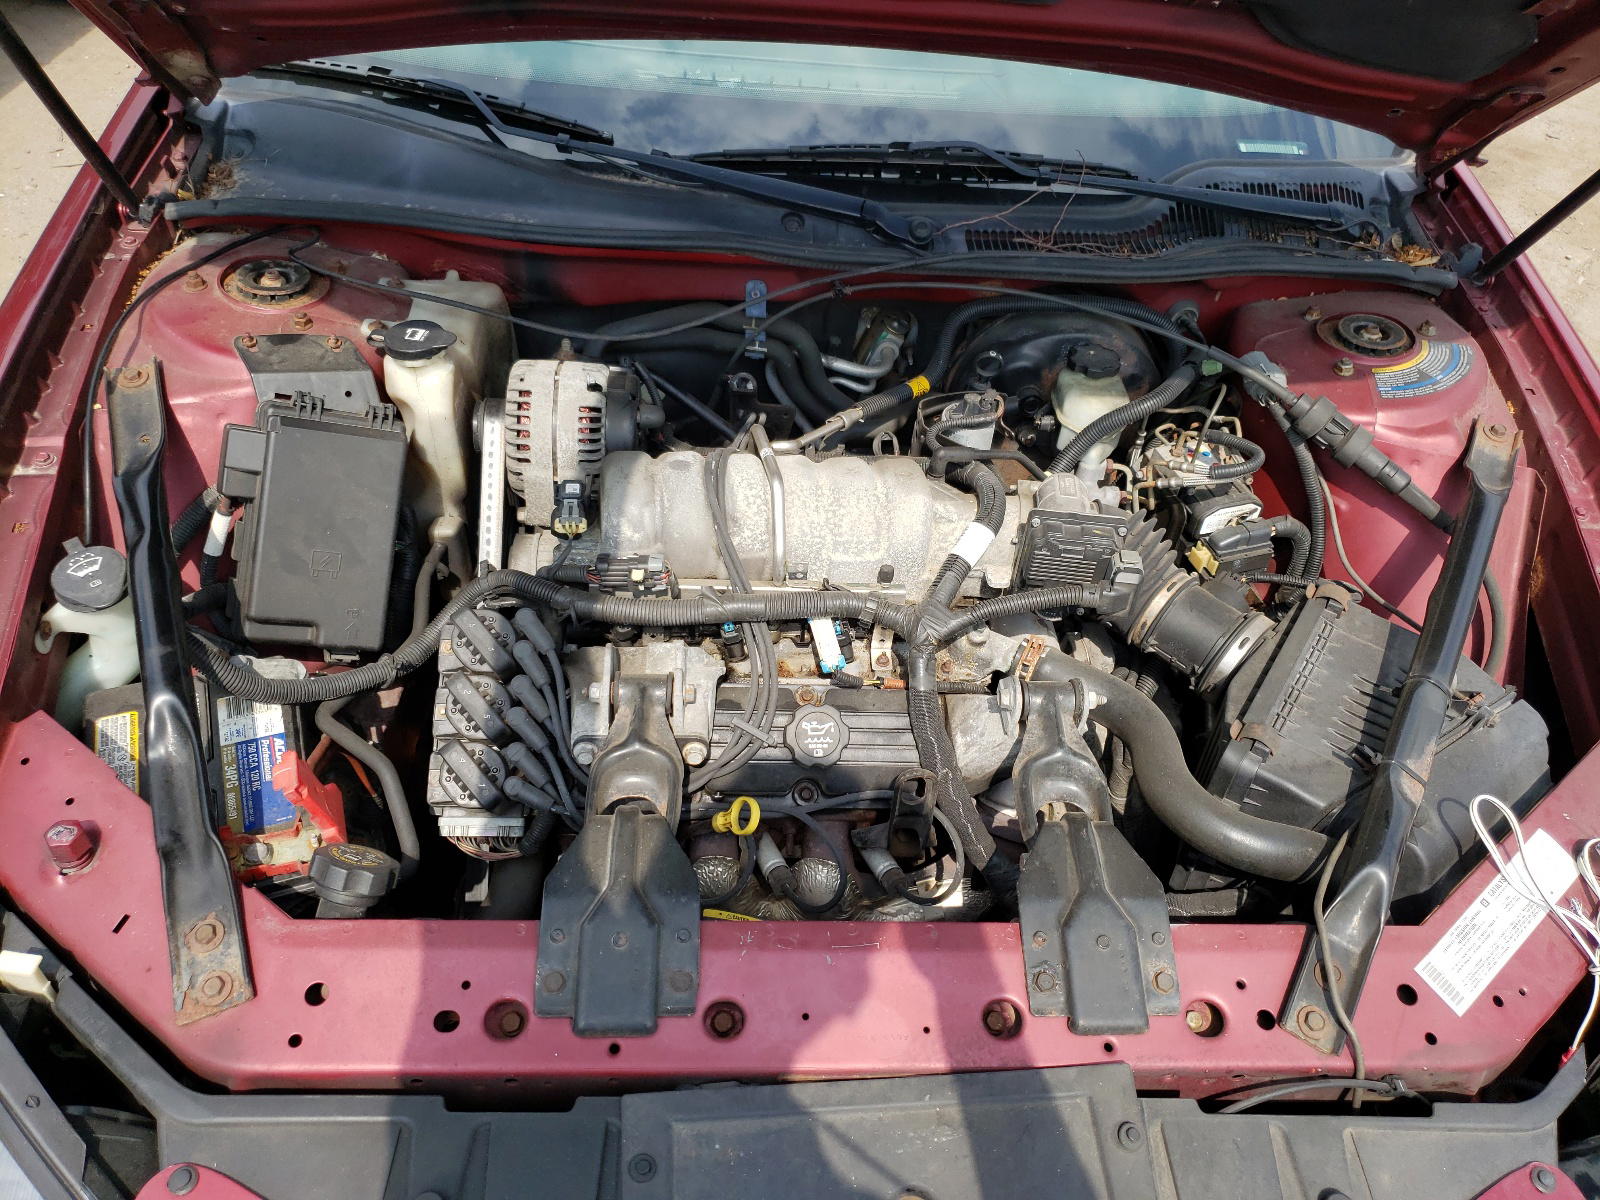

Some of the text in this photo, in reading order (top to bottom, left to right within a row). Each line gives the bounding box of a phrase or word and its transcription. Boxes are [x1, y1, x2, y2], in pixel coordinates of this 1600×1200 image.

[247, 742, 257, 754] 750
[249, 753, 259, 768] CCA
[261, 739, 273, 782] Professional
[224, 765, 239, 789] 34PG
[250, 769, 260, 781] 120
[251, 780, 262, 791] RC
